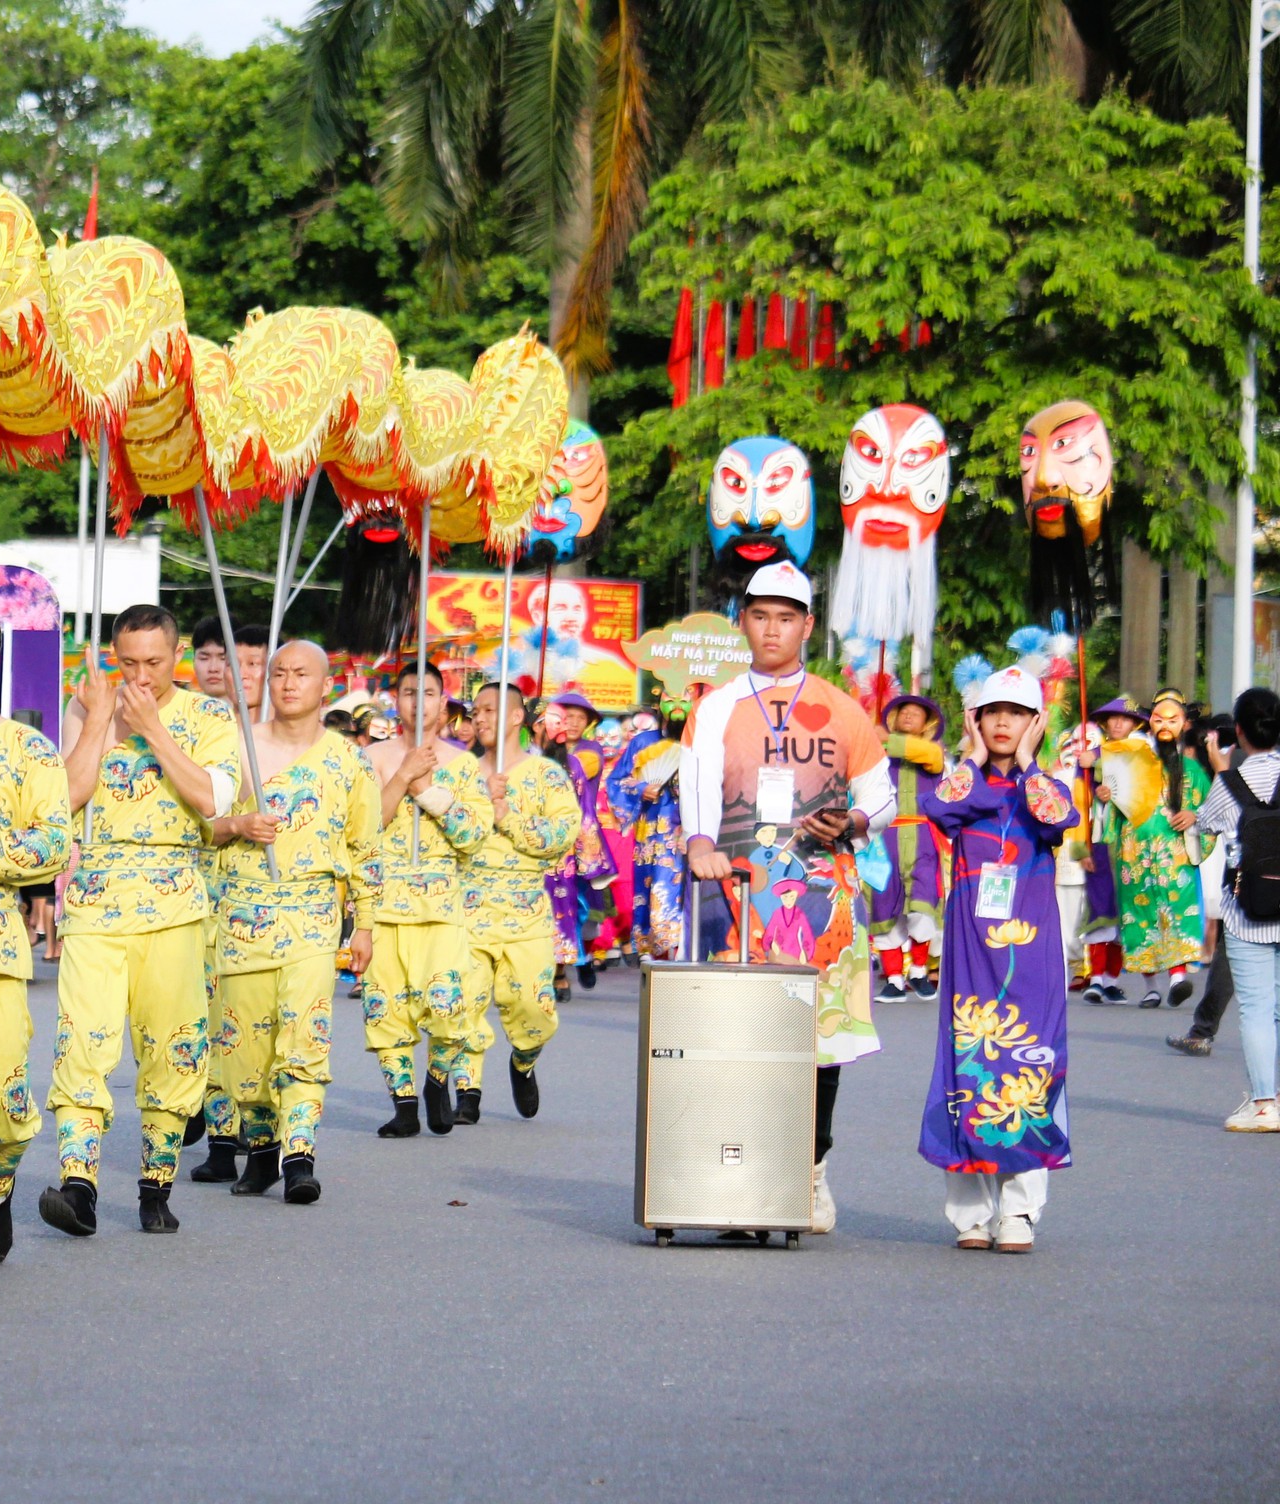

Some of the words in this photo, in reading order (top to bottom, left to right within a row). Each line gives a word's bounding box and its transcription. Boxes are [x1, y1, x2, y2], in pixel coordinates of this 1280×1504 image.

[671, 632, 702, 645] NGHỆ
[704, 635, 740, 649] THUẬT
[650, 644, 682, 661] MẶT
[683, 649, 704, 663] NẠ
[688, 663, 719, 677] HUẾ
[769, 700, 790, 732] I
[763, 736, 837, 768] HUE
